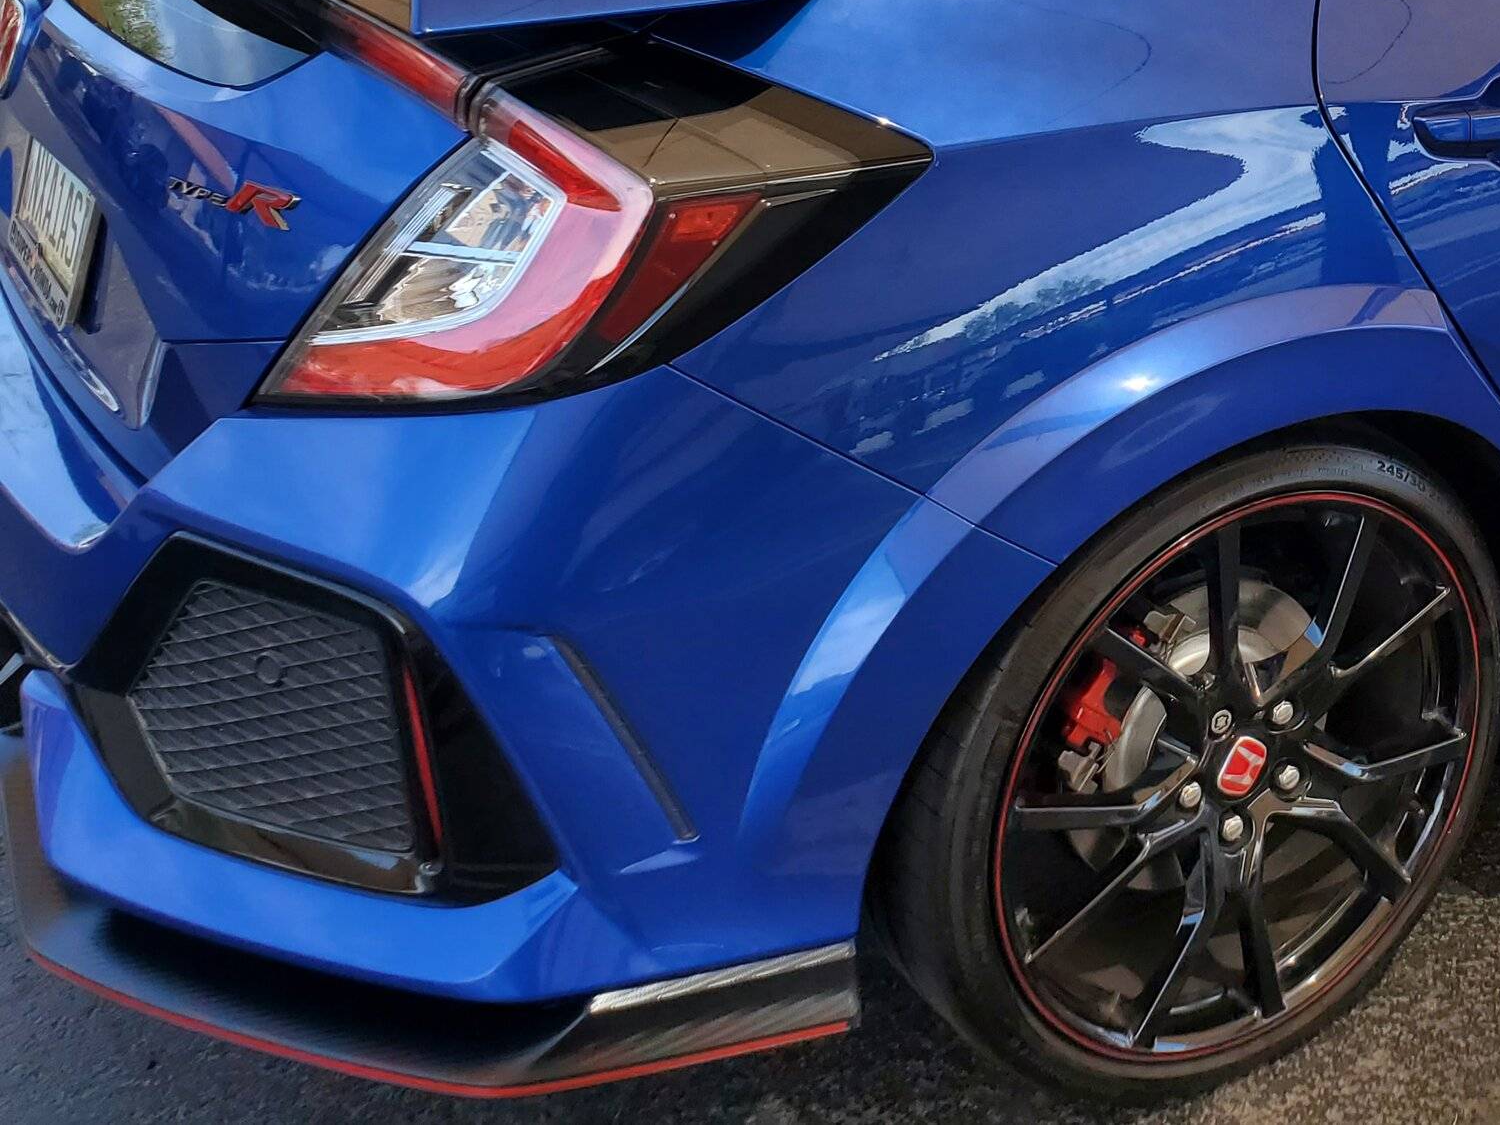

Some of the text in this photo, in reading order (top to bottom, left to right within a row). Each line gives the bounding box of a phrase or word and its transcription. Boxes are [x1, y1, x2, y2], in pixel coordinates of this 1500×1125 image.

[169, 176, 301, 230] TYPE R
[1377, 460, 1426, 492] 245/30
